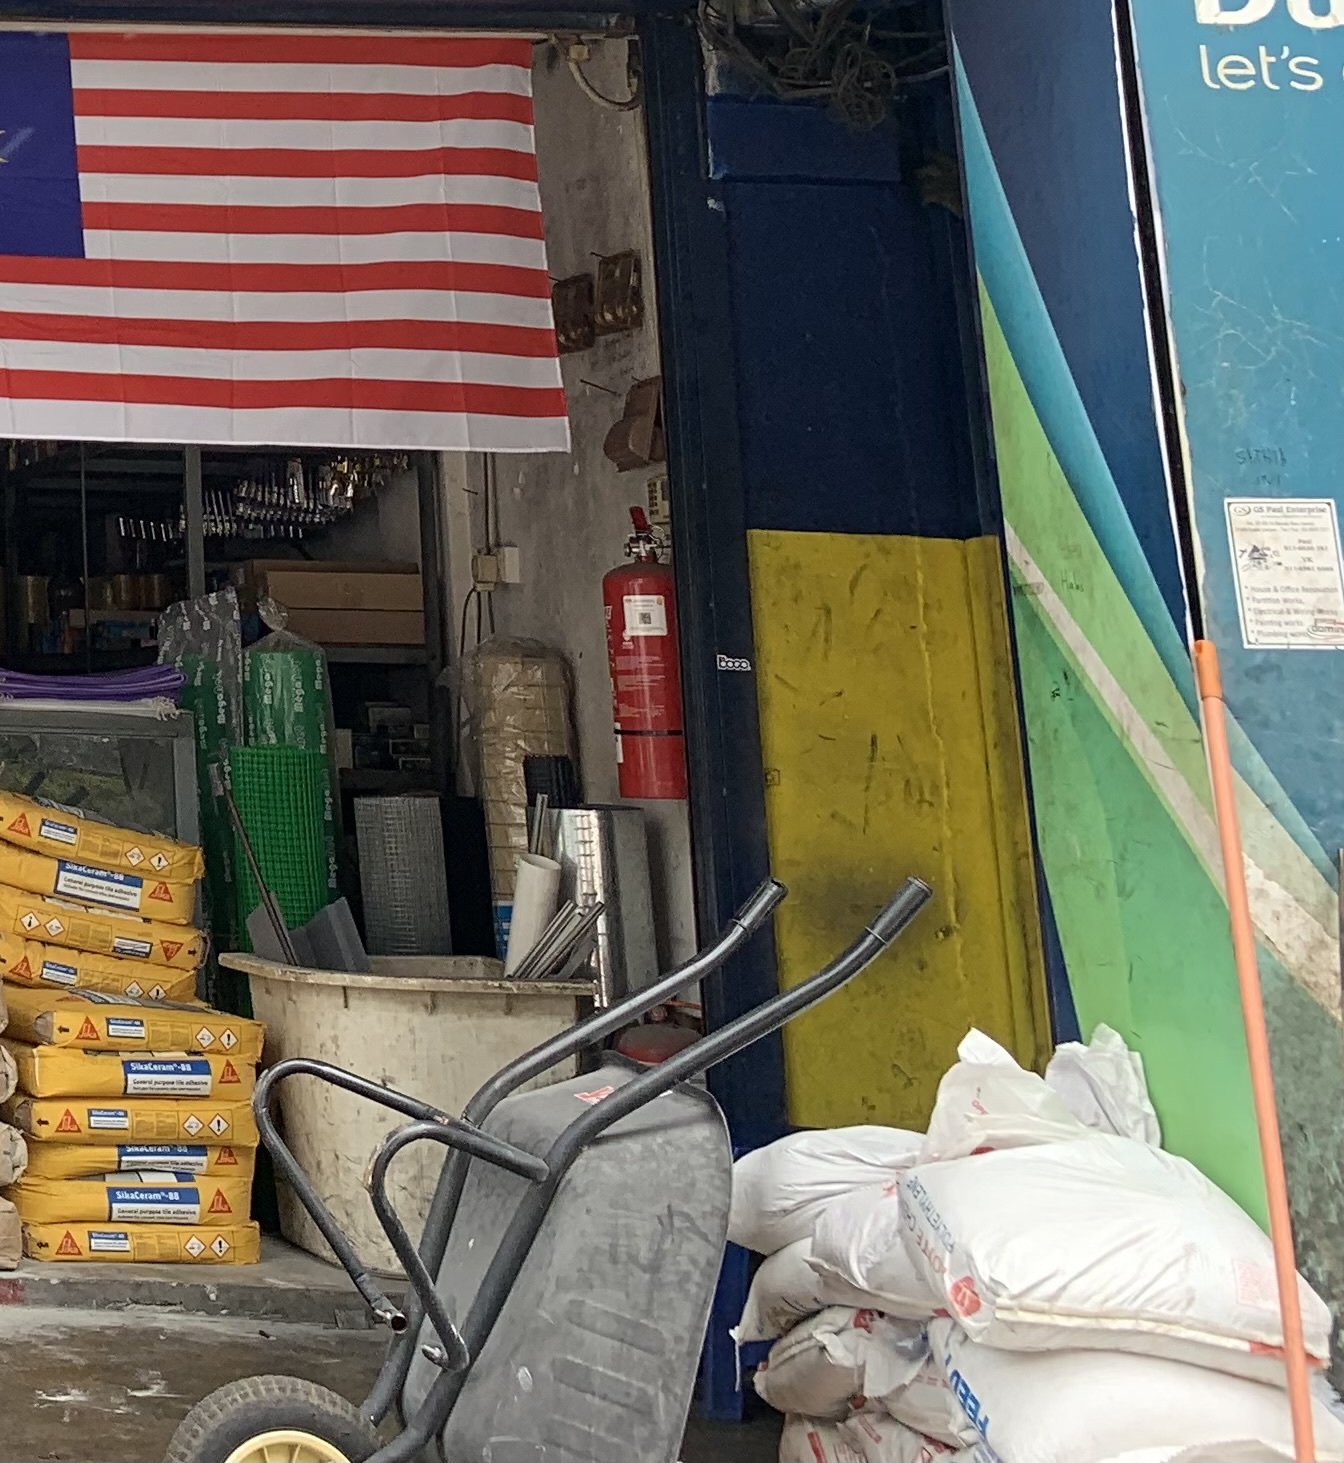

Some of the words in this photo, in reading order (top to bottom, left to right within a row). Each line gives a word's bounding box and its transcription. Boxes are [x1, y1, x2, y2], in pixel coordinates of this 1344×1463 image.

[1199, 44, 1324, 90] let's
[1286, 506, 1327, 515] Enterprise
[1311, 625, 1344, 633] domin
